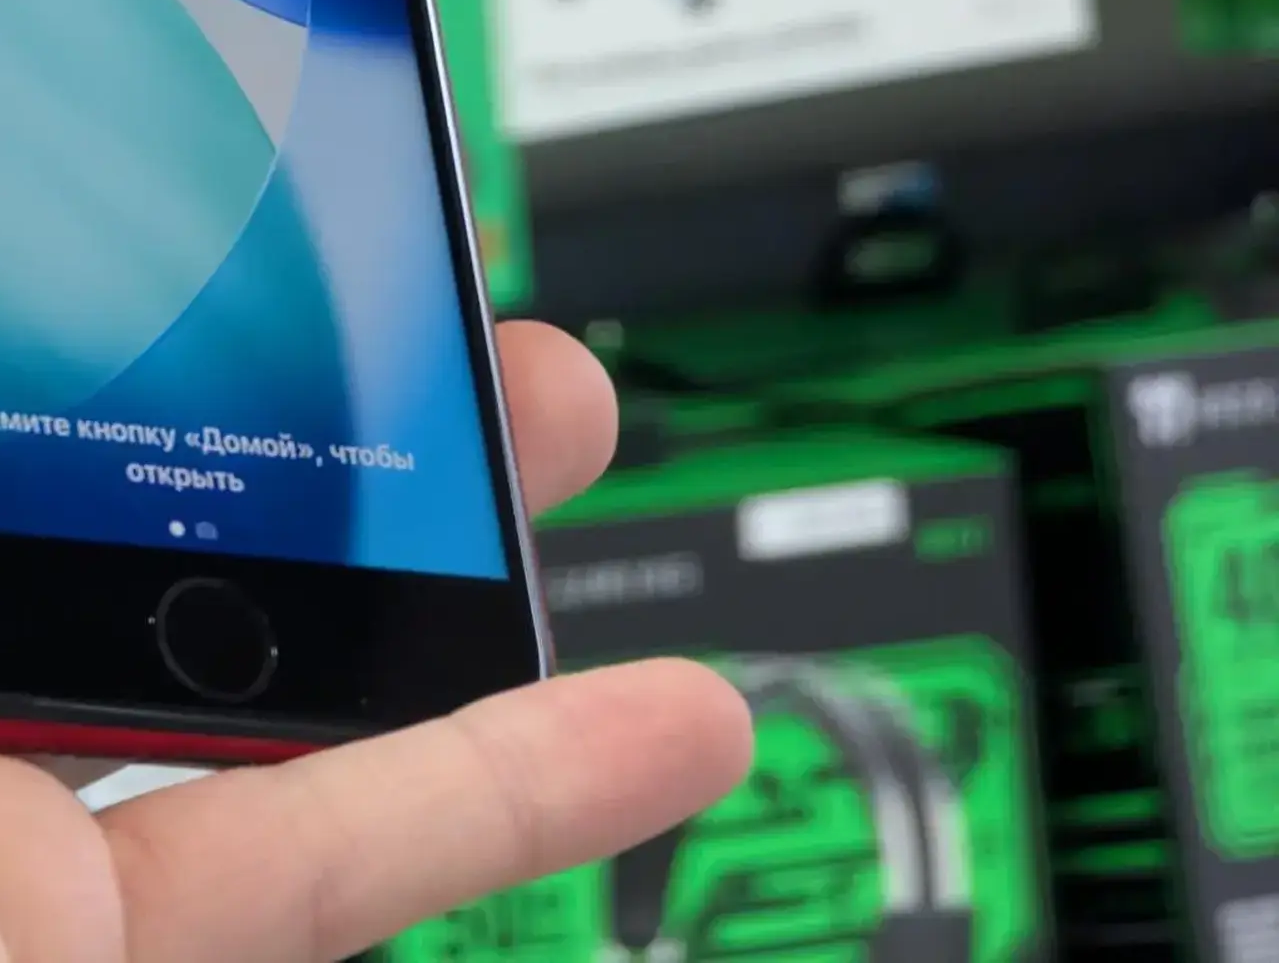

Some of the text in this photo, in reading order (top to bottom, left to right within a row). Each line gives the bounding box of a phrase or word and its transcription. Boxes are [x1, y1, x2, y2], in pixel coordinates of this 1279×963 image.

[76, 418, 177, 453] кнопку
[183, 425, 324, 468] «Домой»,
[328, 442, 415, 471] чтобы
[125, 461, 246, 493] открыть
